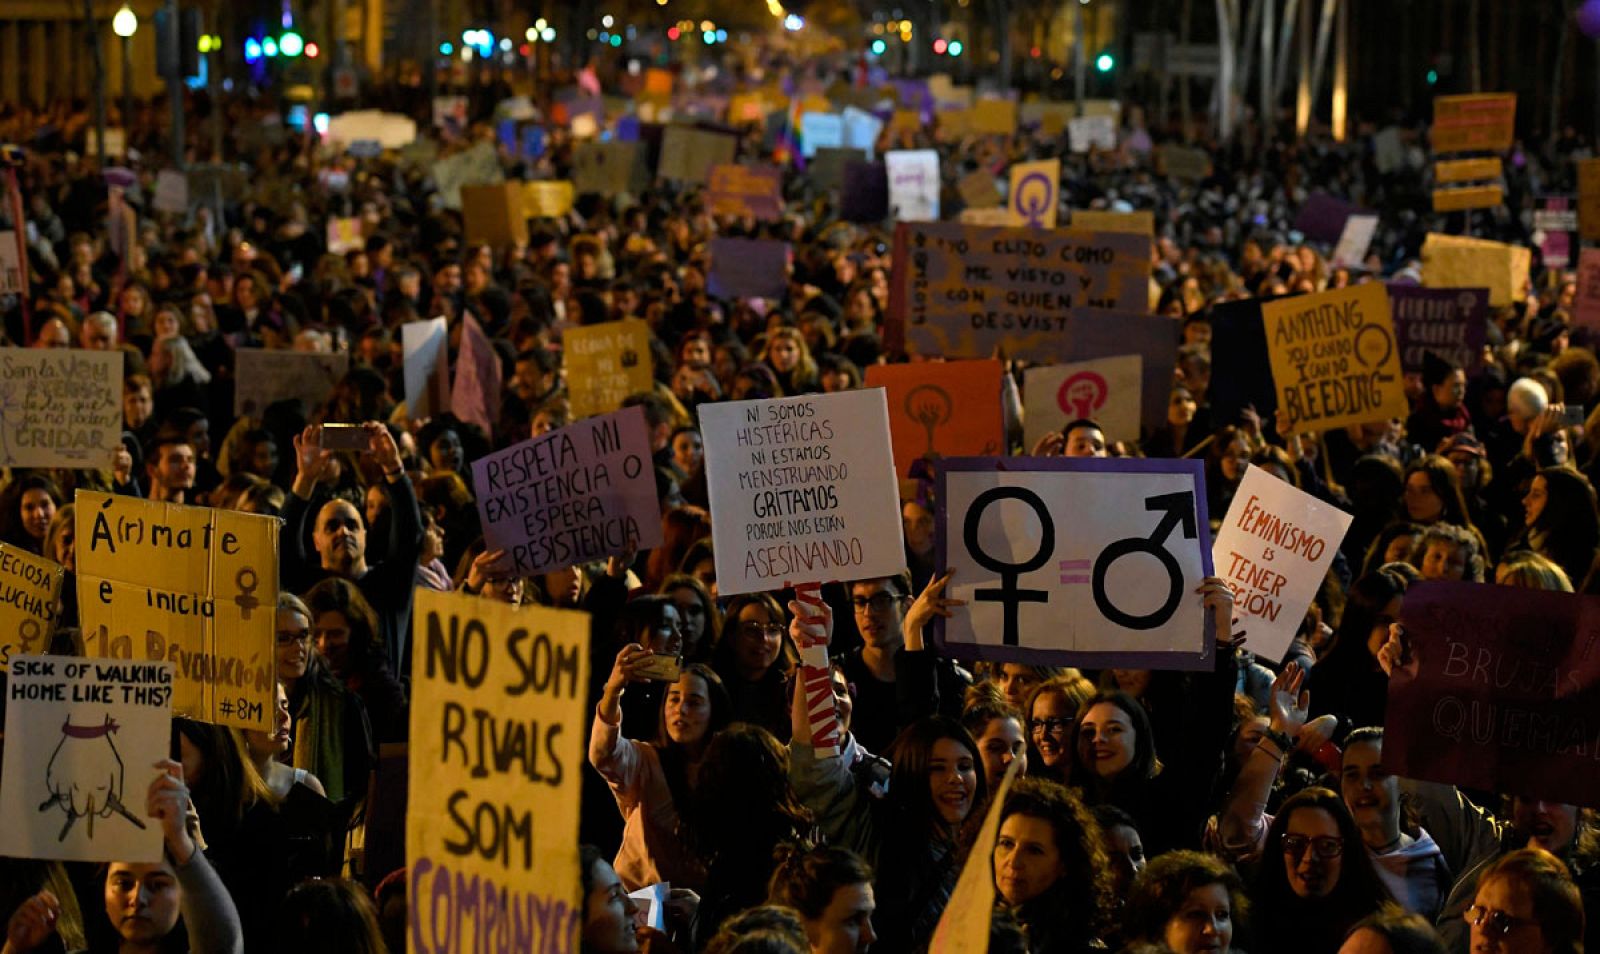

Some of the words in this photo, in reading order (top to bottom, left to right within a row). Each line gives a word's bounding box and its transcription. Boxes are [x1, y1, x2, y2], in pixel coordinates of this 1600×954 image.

[992, 239, 1047, 258] ELIJO
[1060, 244, 1115, 265] COMO
[965, 265, 992, 281] ME
[1007, 267, 1065, 286] VISTO
[1078, 276, 1092, 290] Y
[945, 287, 985, 303] CON
[1006, 289, 1072, 311] QUIEN
[971, 311, 1067, 332] DESVIST
[1274, 299, 1364, 347] ANYTHING
[1286, 346, 1309, 366] YOU
[1312, 341, 1337, 359] CAN
[1295, 363, 1308, 384] I
[1309, 361, 1331, 379] CAN
[1333, 357, 1349, 375] DO
[746, 404, 760, 423] NI
[769, 402, 816, 422] SOMOS
[1283, 370, 1383, 426] BLEEDING
[15, 427, 105, 450] CRIDAR
[736, 418, 836, 448] HISTÉRICAS
[486, 432, 578, 494] RESPETA
[591, 418, 622, 457] MI
[751, 451, 766, 466] NI
[772, 444, 832, 466] ESTAMOS
[484, 462, 611, 525] EXISTENCIA
[623, 454, 643, 480] O
[738, 462, 849, 491] MENSTRUANDO
[523, 495, 606, 538] ESPERA
[753, 485, 839, 520] GRITAMOS
[745, 520, 785, 542] PORQUE
[787, 518, 813, 537] NOS
[814, 513, 846, 533] ESTÁN
[1236, 494, 1327, 563] FEMINISMO
[513, 514, 642, 574] RESISTENCIA
[744, 537, 864, 581] ASESINANDO
[1229, 551, 1288, 599] TENER
[99, 580, 113, 605] e
[424, 610, 490, 690] NO
[503, 627, 579, 700] SOM
[1443, 640, 1582, 699] BRUJAS
[11, 660, 55, 677] SICK
[64, 663, 92, 680] OF
[96, 664, 172, 684] WALKING
[11, 683, 67, 701] HOME
[72, 684, 114, 703] LIKE
[120, 685, 173, 708] THIS?
[219, 695, 264, 724] #8M
[1432, 695, 1600, 761] QUEMA
[441, 701, 564, 789] RIVALS
[443, 789, 533, 871] SOM
